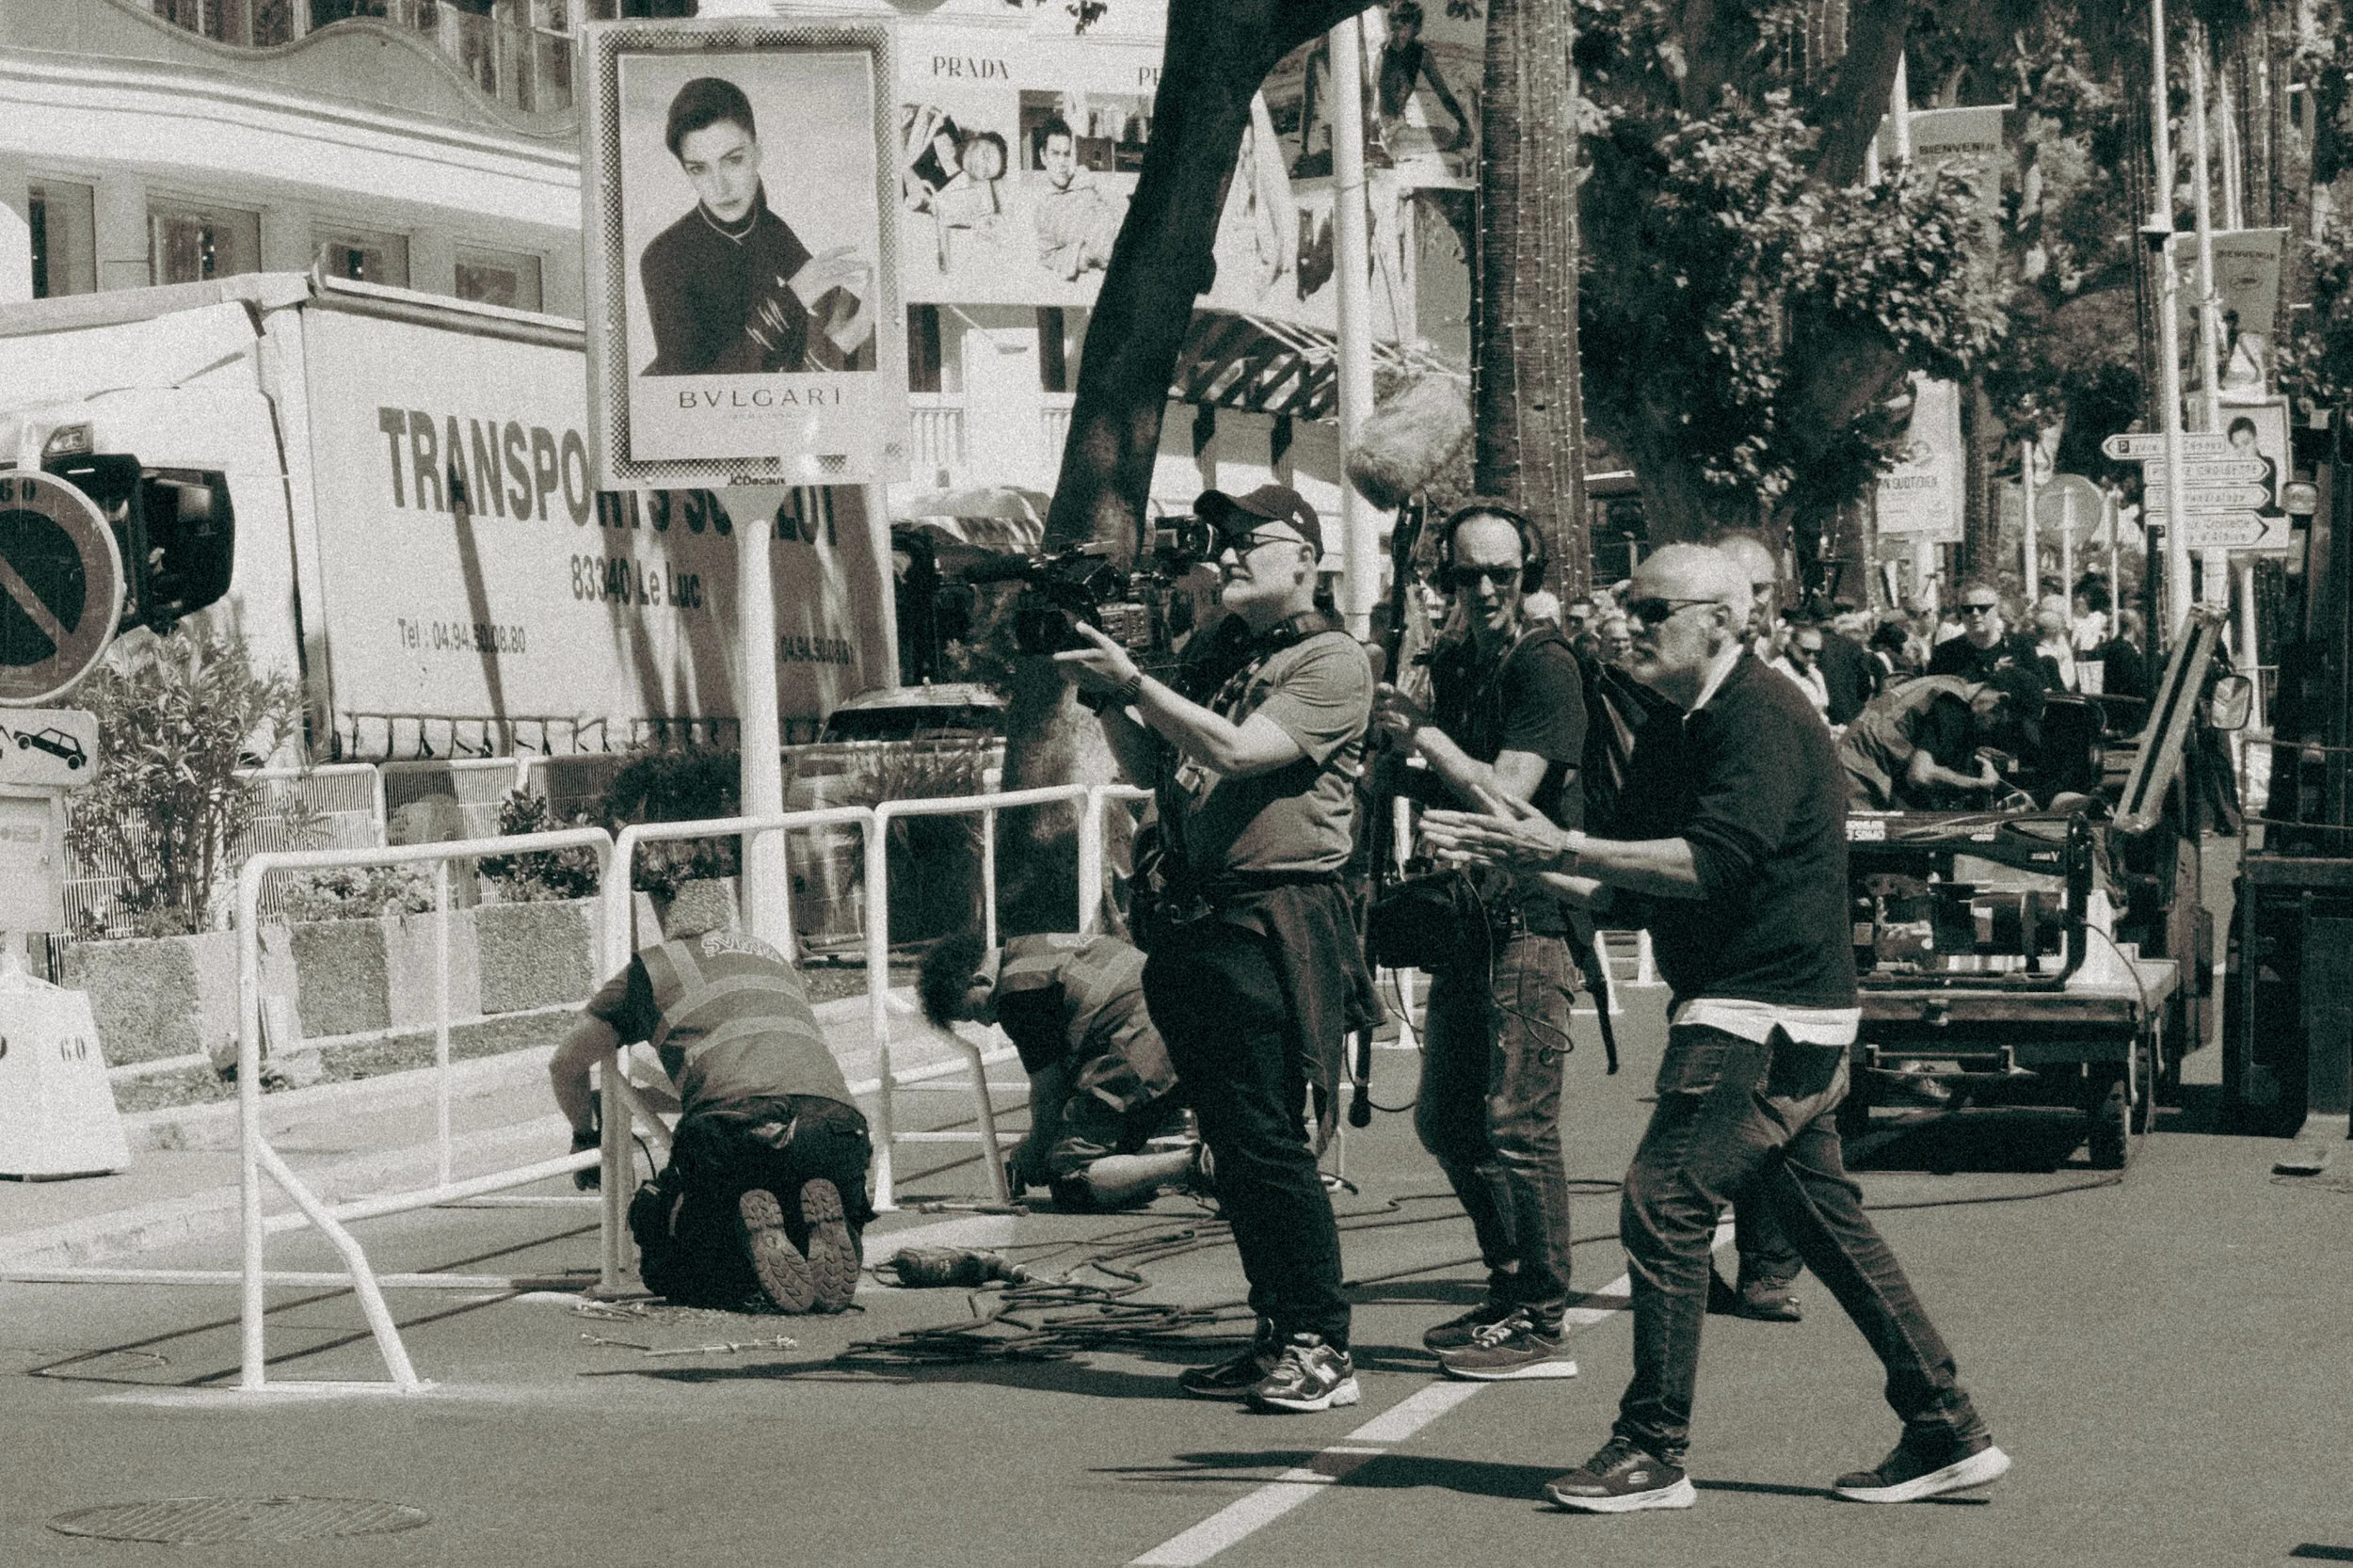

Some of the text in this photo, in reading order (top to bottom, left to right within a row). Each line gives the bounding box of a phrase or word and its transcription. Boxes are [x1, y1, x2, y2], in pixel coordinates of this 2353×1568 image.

[933, 56, 1009, 80] PRADA
[679, 387, 840, 408] BVLGARI
[728, 472, 787, 487] JCDecaux
[570, 553, 703, 610] 83340 Le Luc
